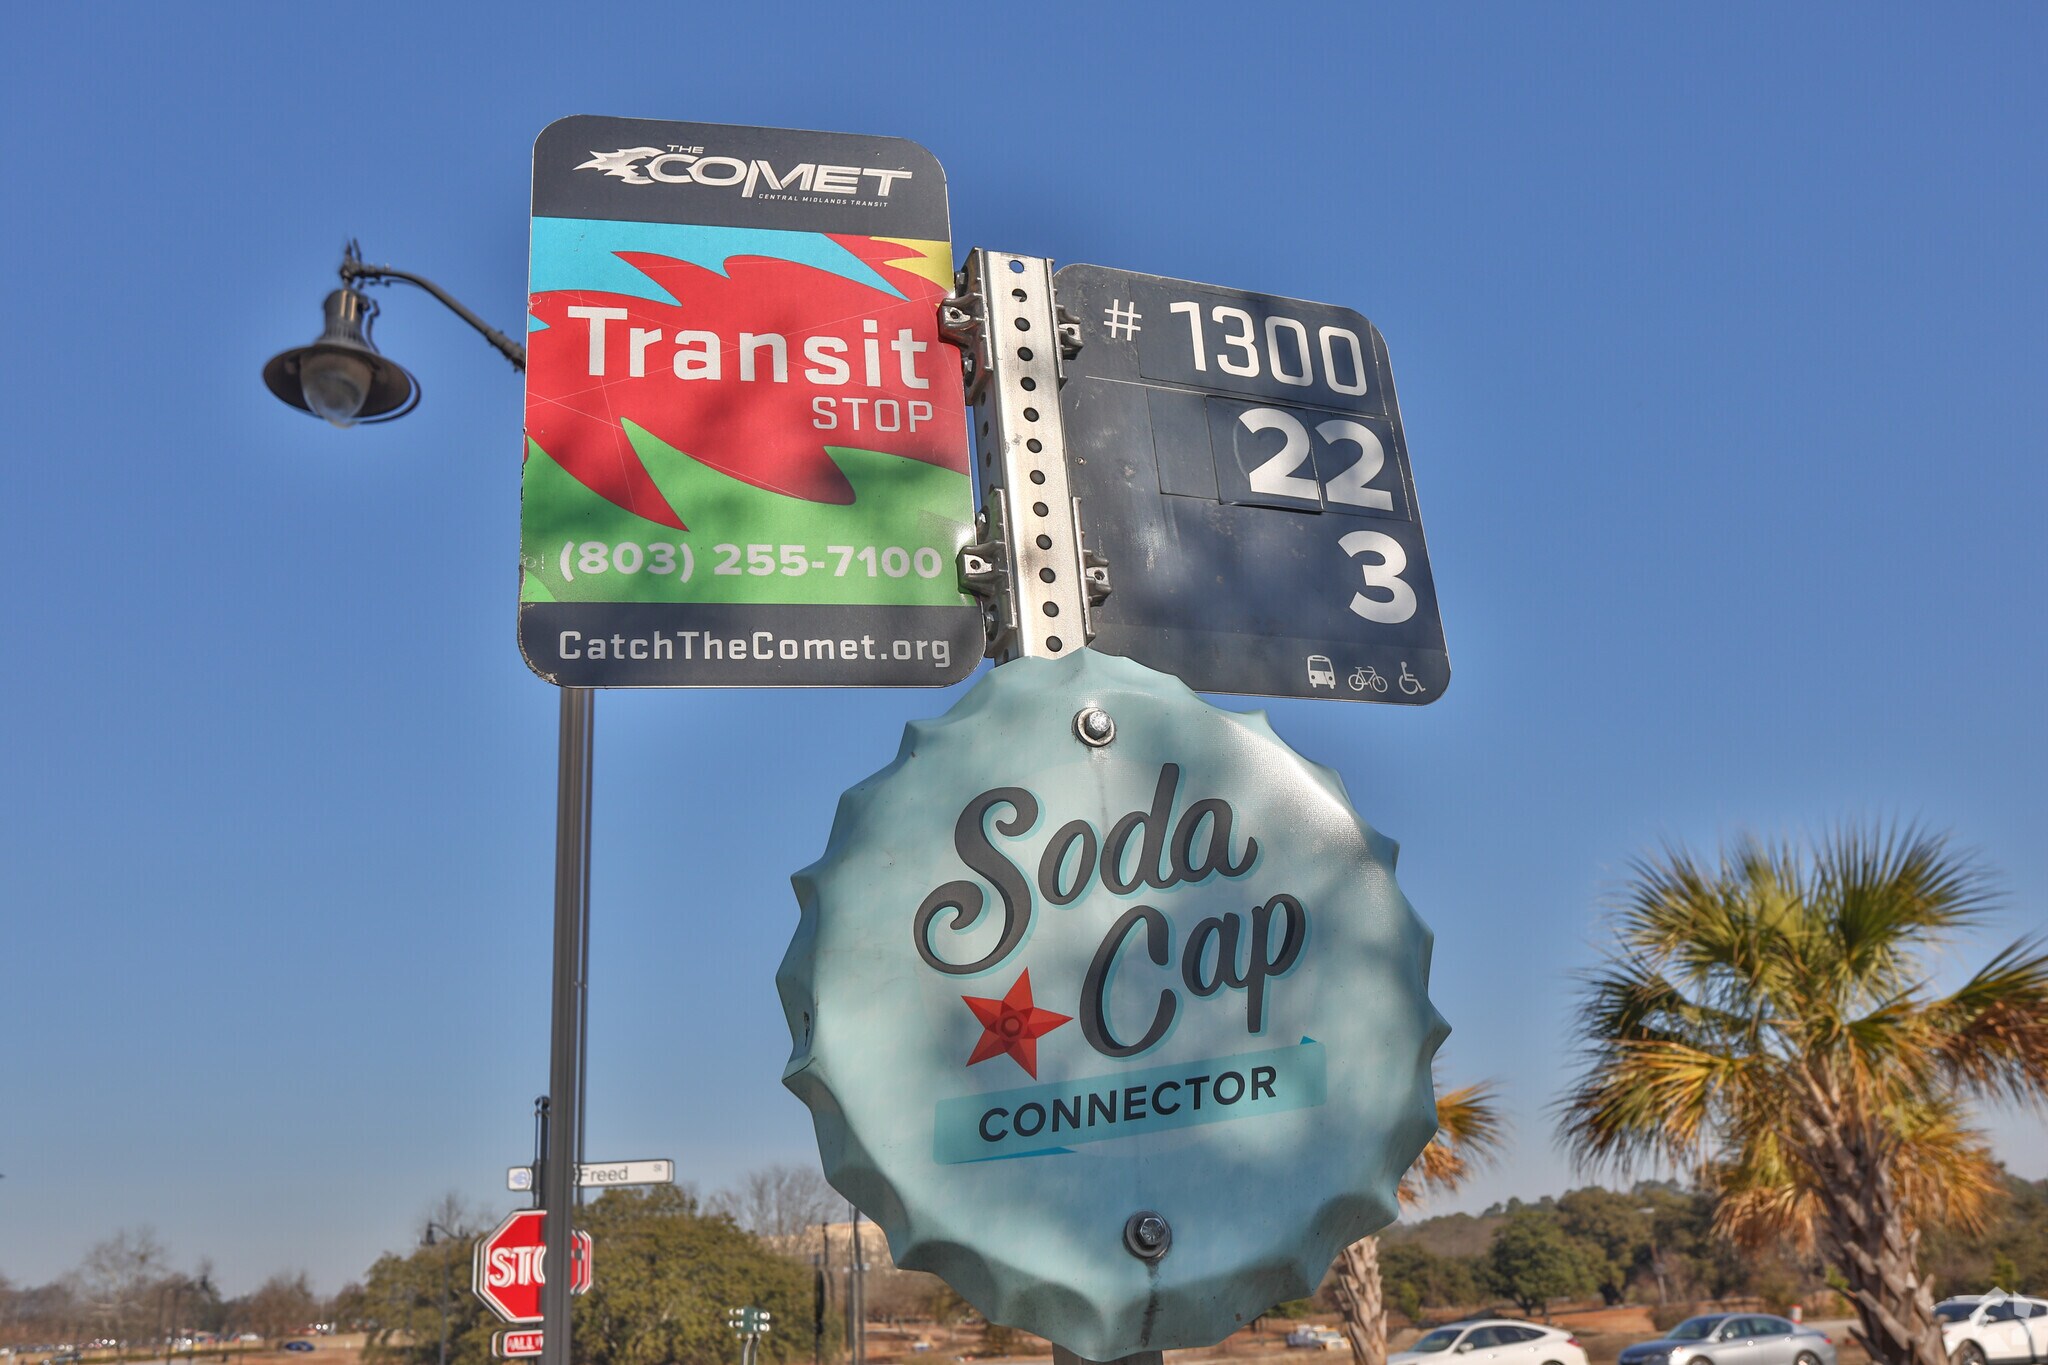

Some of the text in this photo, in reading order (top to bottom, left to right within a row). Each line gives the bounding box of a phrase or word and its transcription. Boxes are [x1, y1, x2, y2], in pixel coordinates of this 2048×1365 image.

[666, 144, 704, 154] THE
[645, 154, 913, 198] COMET
[758, 193, 889, 208] CENTRAL MIDLANDS TRANSIT
[567, 306, 930, 390] Transit
[1103, 299, 1368, 397] # 1300
[812, 396, 934, 433] STOP
[1238, 407, 1395, 512] 22
[559, 541, 943, 584] (803) 255-7100
[1337, 530, 1417, 624] 3
[559, 630, 951, 668] CatchTheComet.org
[913, 762, 1260, 976] Soda
[1079, 893, 1308, 1058] Cap
[978, 1065, 1277, 1143] CONNECTOR
[580, 1166, 628, 1182] Freed
[489, 1245, 573, 1288] STO
